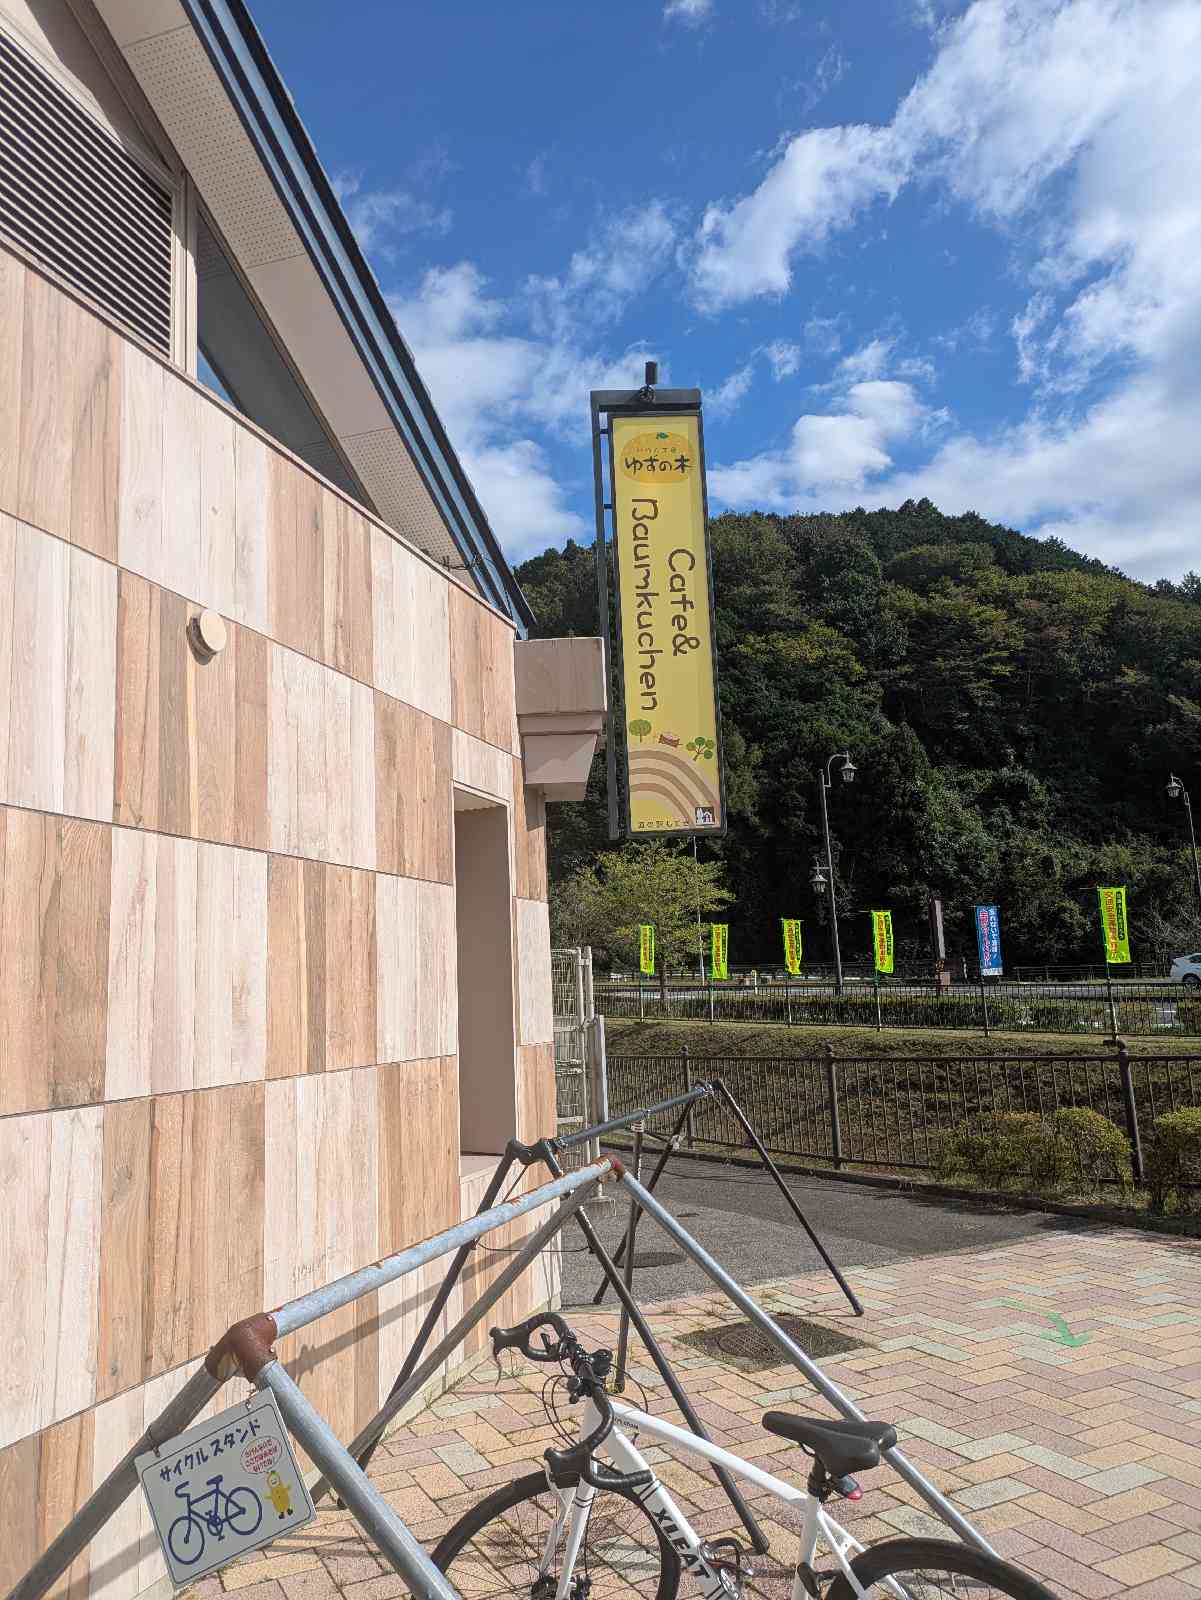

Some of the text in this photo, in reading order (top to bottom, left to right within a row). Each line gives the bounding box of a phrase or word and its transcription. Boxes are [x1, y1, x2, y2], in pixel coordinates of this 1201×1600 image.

[625, 454, 693, 475] ゆずの木
[632, 498, 663, 711] Baumkuchen
[668, 548, 700, 656] Cafe&
[160, 1419, 261, 1481] サイクルスタンド
